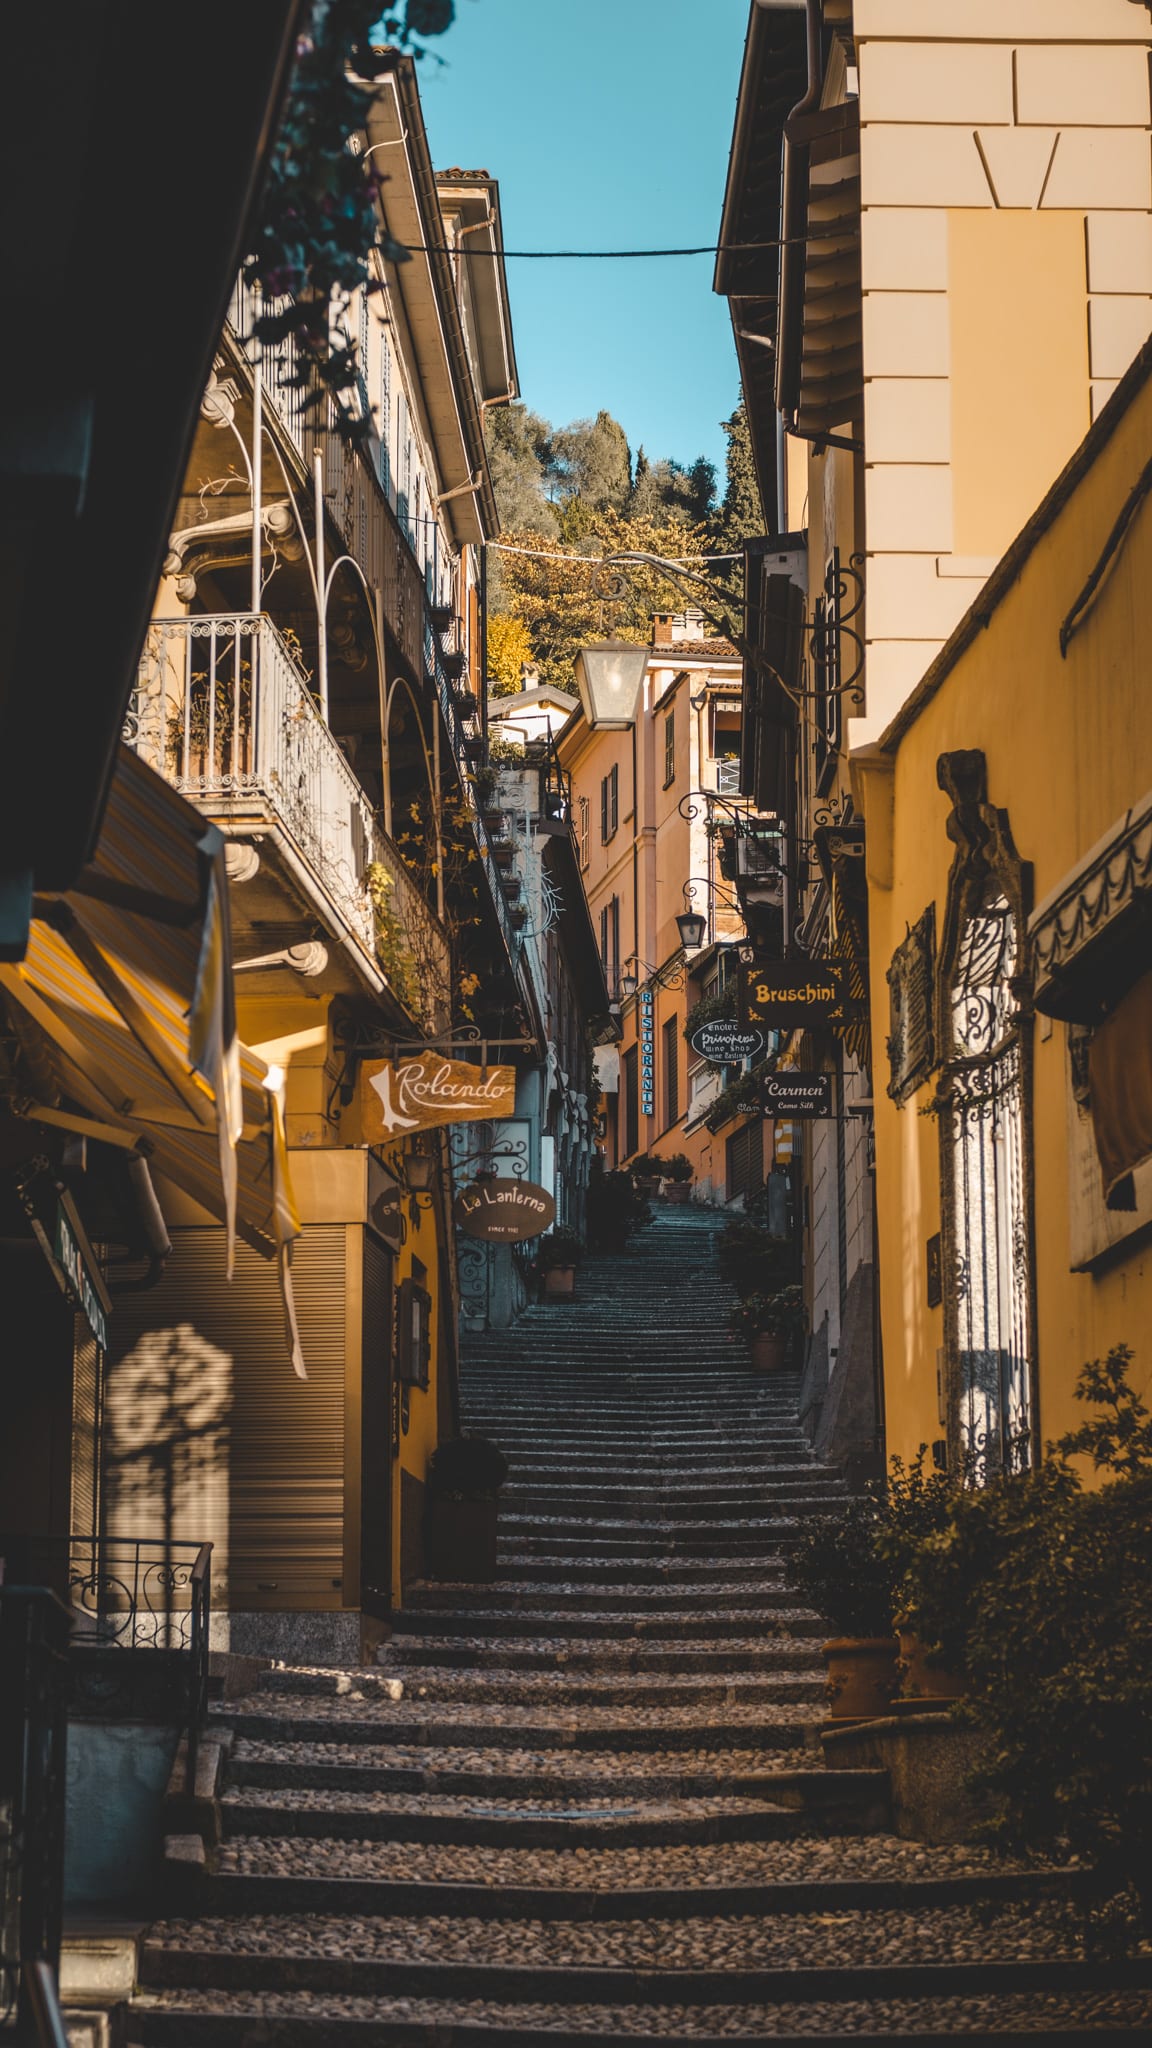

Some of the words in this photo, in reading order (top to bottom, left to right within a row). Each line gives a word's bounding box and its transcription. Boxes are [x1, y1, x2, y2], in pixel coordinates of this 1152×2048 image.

[755, 983, 836, 1005] Bruschini
[708, 1024, 739, 1032] enotec
[642, 992, 653, 1115] RISTORANTE
[395, 1063, 512, 1113] Rolando
[768, 1082, 824, 1097] Carmen
[777, 1101, 798, 1110] Como
[799, 1100, 814, 1110] Silk
[462, 1197, 482, 1212] La
[483, 1186, 546, 1213] Lanterna
